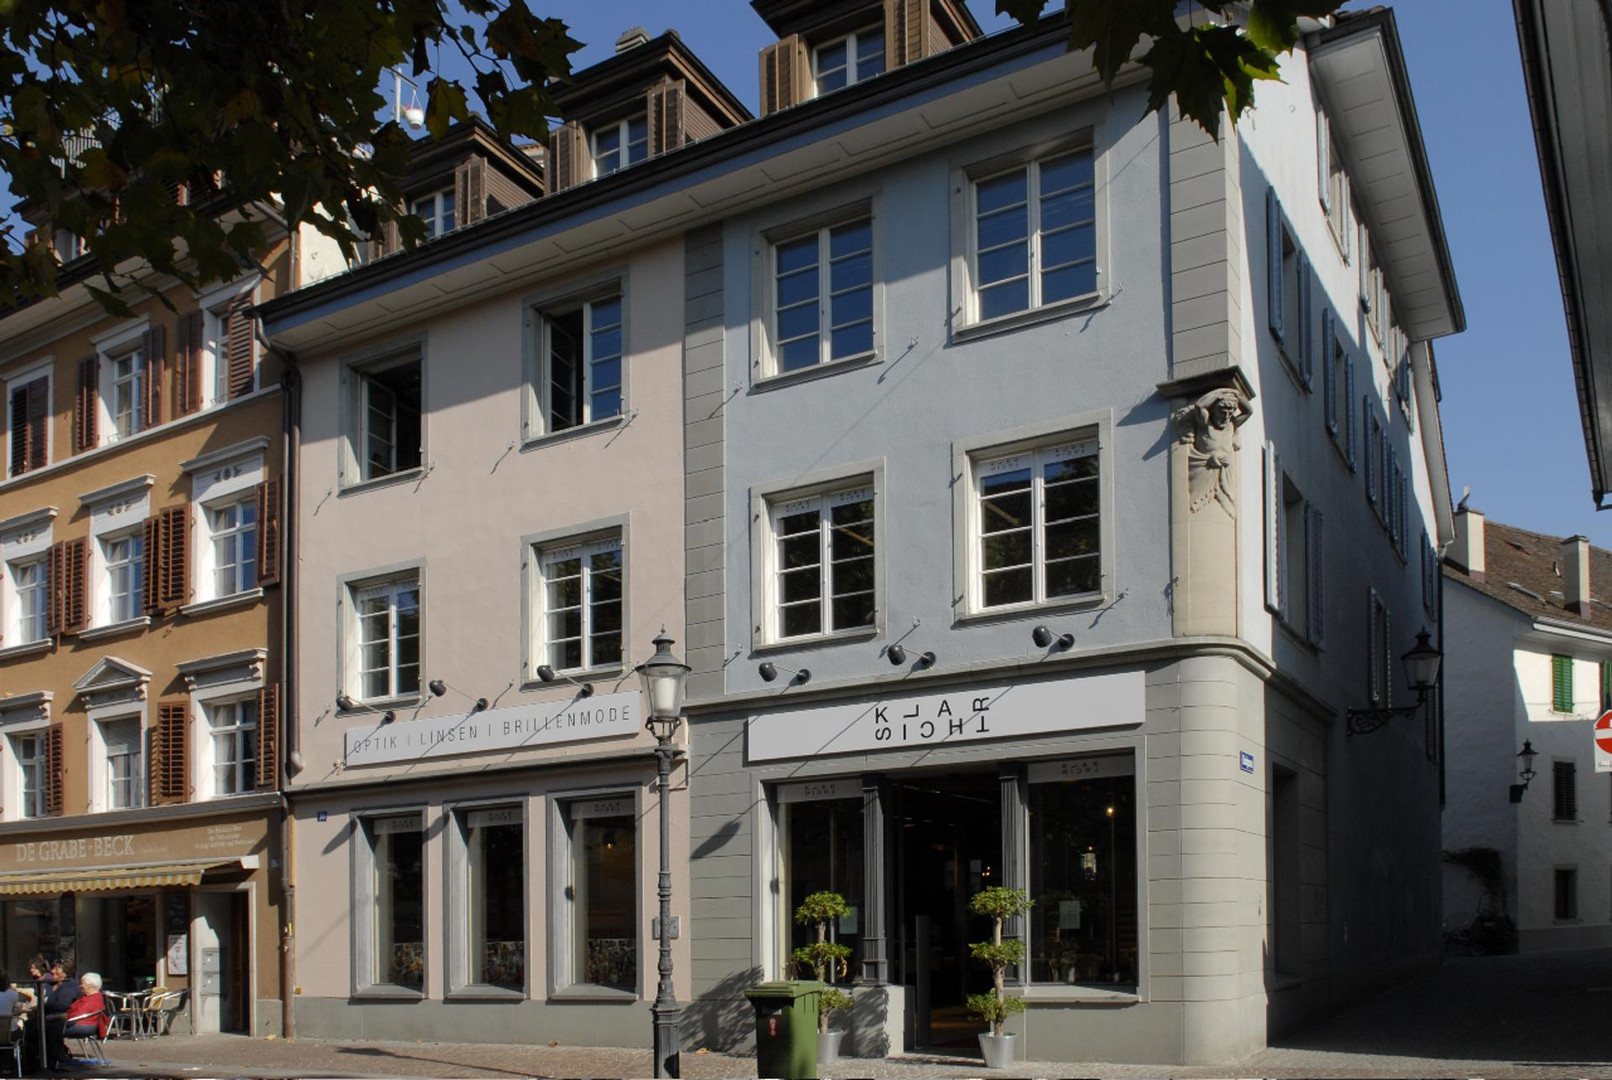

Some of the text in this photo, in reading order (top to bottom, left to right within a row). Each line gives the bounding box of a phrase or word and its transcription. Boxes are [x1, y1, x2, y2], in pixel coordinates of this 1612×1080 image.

[875, 696, 990, 723] KLAR
[353, 735, 398, 753] OPTIK
[420, 726, 478, 746] LINSEN
[503, 705, 631, 735] BRILLENMODE
[875, 715, 990, 741] SICHT
[16, 842, 35, 862] DE
